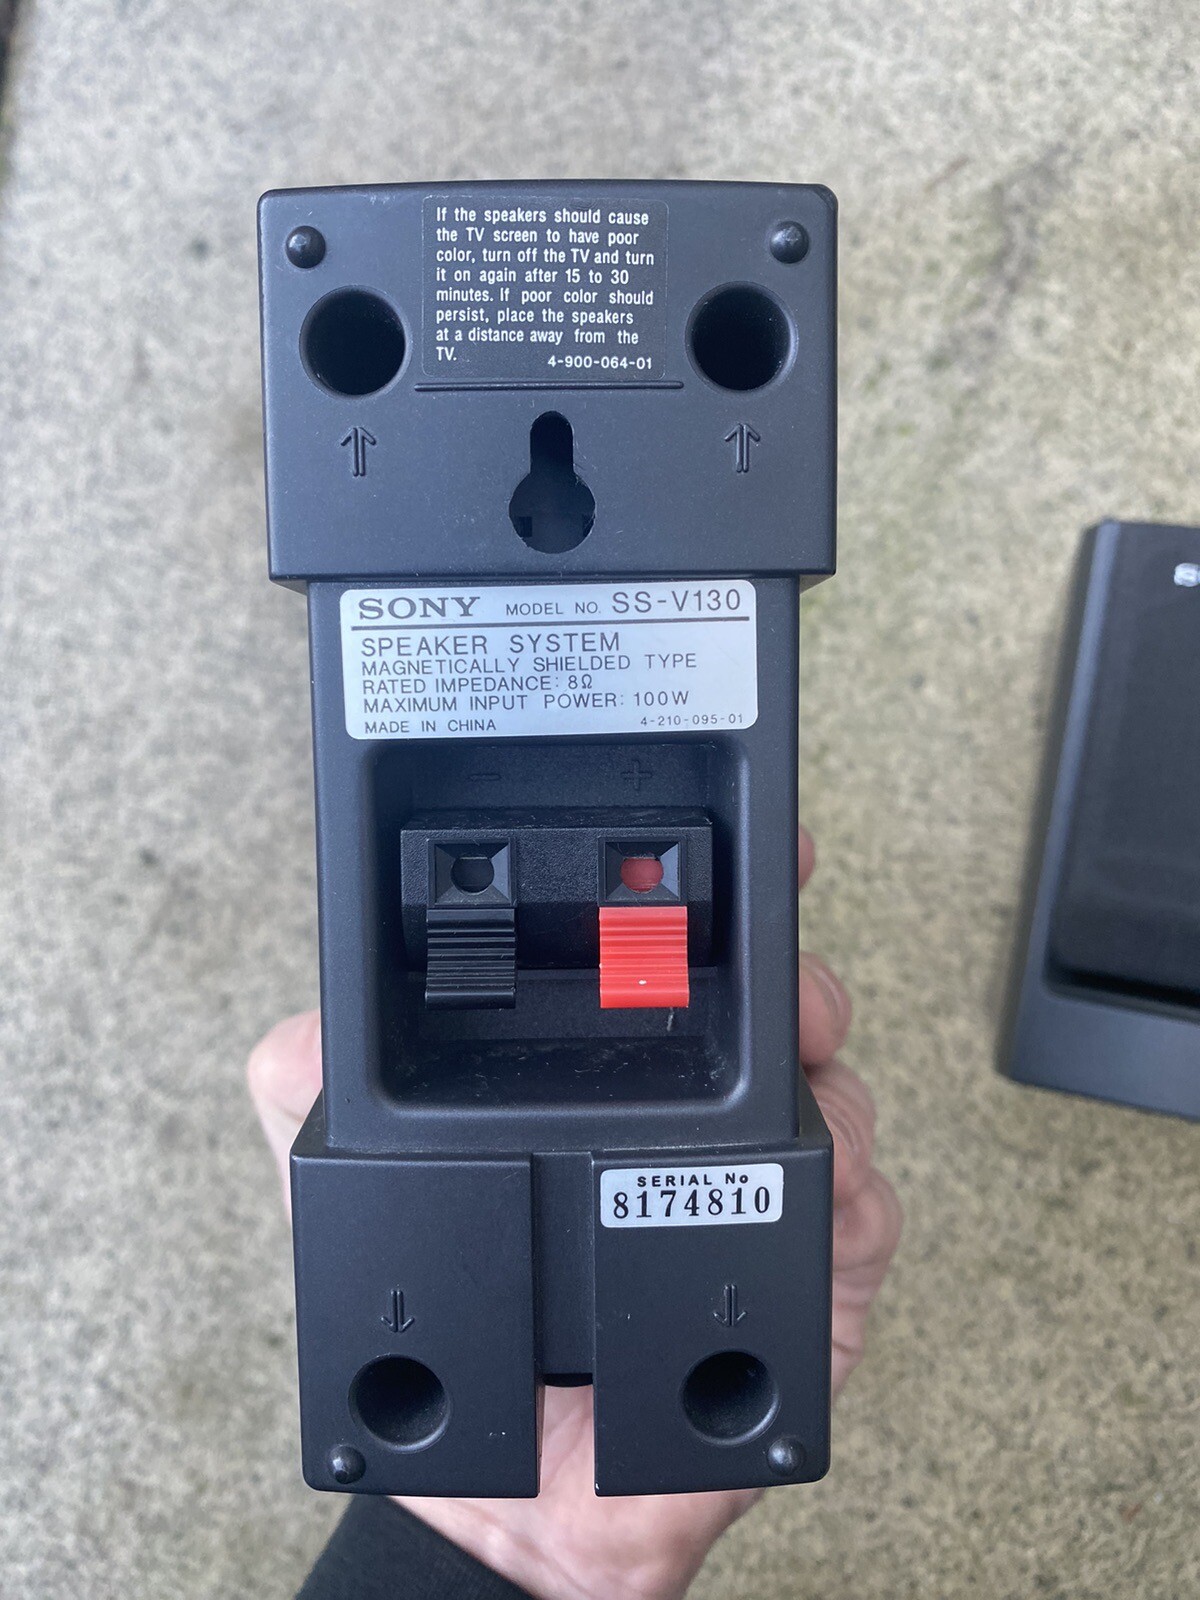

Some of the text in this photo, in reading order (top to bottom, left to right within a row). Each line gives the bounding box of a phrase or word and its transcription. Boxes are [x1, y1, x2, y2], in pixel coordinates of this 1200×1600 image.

[436, 207, 649, 226] If the speakers should cause
[436, 227, 639, 248] the TV screen to have poor
[436, 248, 654, 265] color, turn off the TV and turn
[436, 268, 629, 284] it on again after 15 to 30
[436, 287, 654, 305] minutes. If poor color should
[436, 307, 634, 326] persist, place the speakers
[436, 327, 639, 346] at a distance away from the
[436, 347, 457, 361] TV.
[547, 356, 652, 370] 4-900-064-01
[358, 596, 481, 620] SONY
[505, 588, 741, 616] MODEL NO. SS-V130
[361, 631, 620, 657] SPEAKER SYSTEM
[361, 653, 697, 676] MAGNETICALLY SHIELDED TYPE
[363, 674, 593, 695] RATED IMPEDANCE: 8Ω
[363, 691, 689, 714] MAXIMUM INPUT POWER: 100W
[365, 718, 497, 734] MADE IN CHINA
[640, 713, 743, 727] 4-210-095-01
[637, 1173, 749, 1187] SERIAL No
[613, 1186, 770, 1219] 8174810
